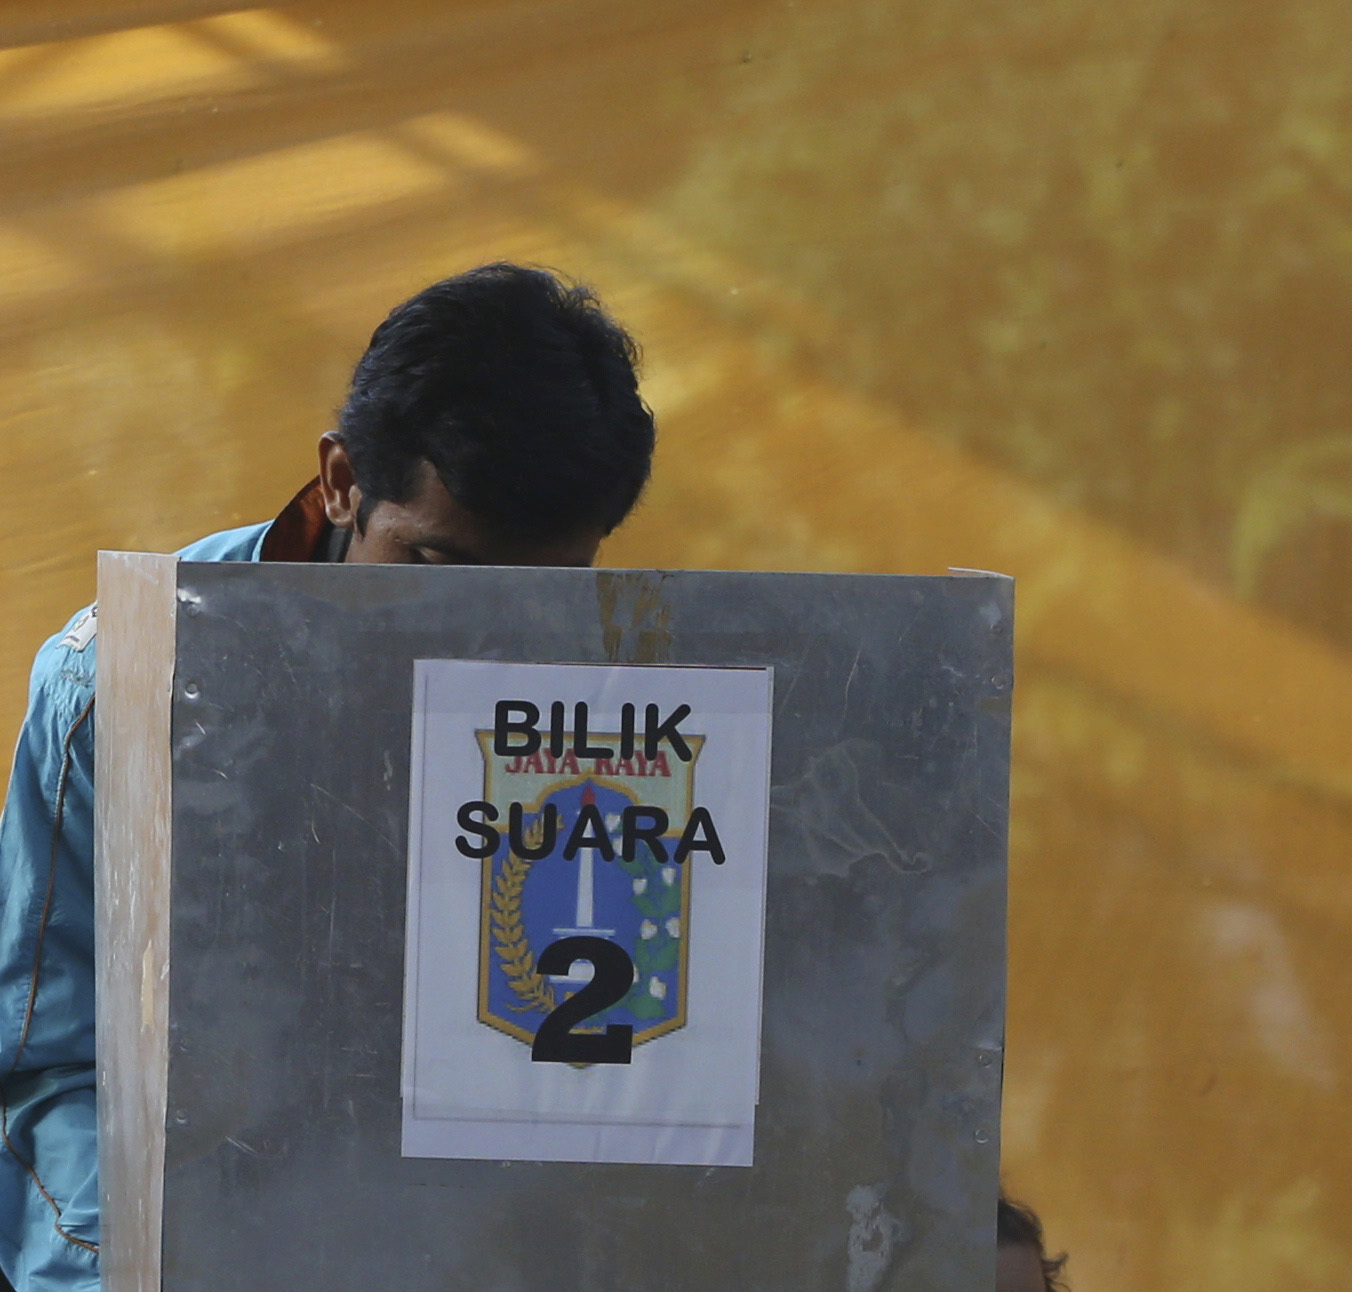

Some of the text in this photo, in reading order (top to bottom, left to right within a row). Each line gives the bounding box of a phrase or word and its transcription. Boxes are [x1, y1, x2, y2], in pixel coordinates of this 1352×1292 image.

[494, 700, 692, 762] BILIK
[505, 748, 581, 775] JAYA
[455, 801, 726, 865] SUARA
[531, 936, 634, 1064] 2
